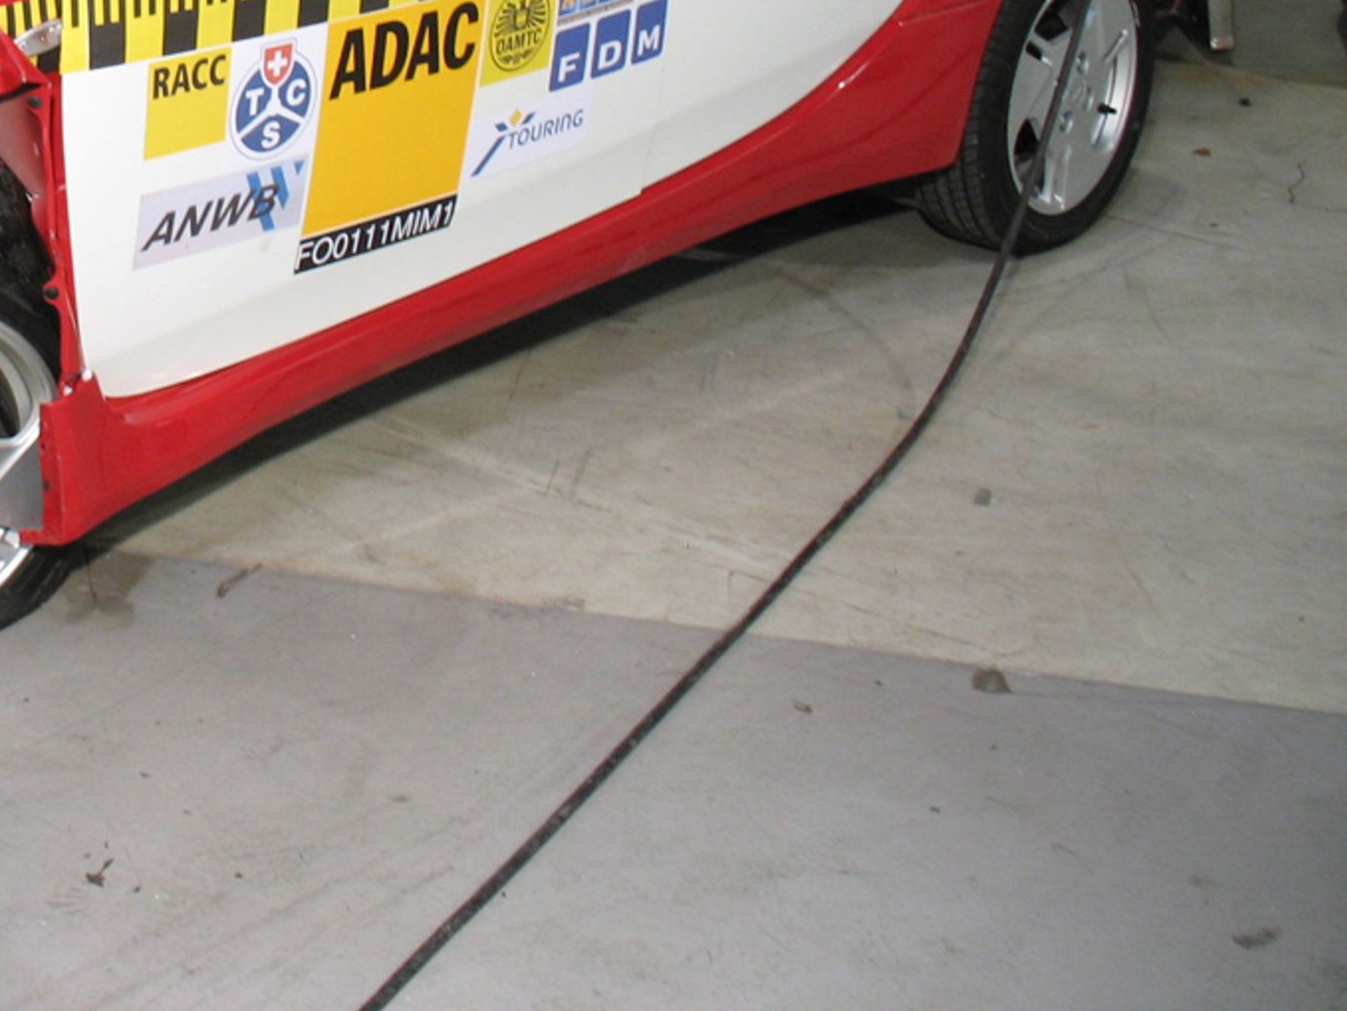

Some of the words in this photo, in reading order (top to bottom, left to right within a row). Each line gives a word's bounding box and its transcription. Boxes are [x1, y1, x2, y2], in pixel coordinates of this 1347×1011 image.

[153, 54, 227, 100] RACC
[329, 1, 479, 101] ADAC
[508, 109, 584, 150] TOURING
[140, 184, 280, 252] ANWB
